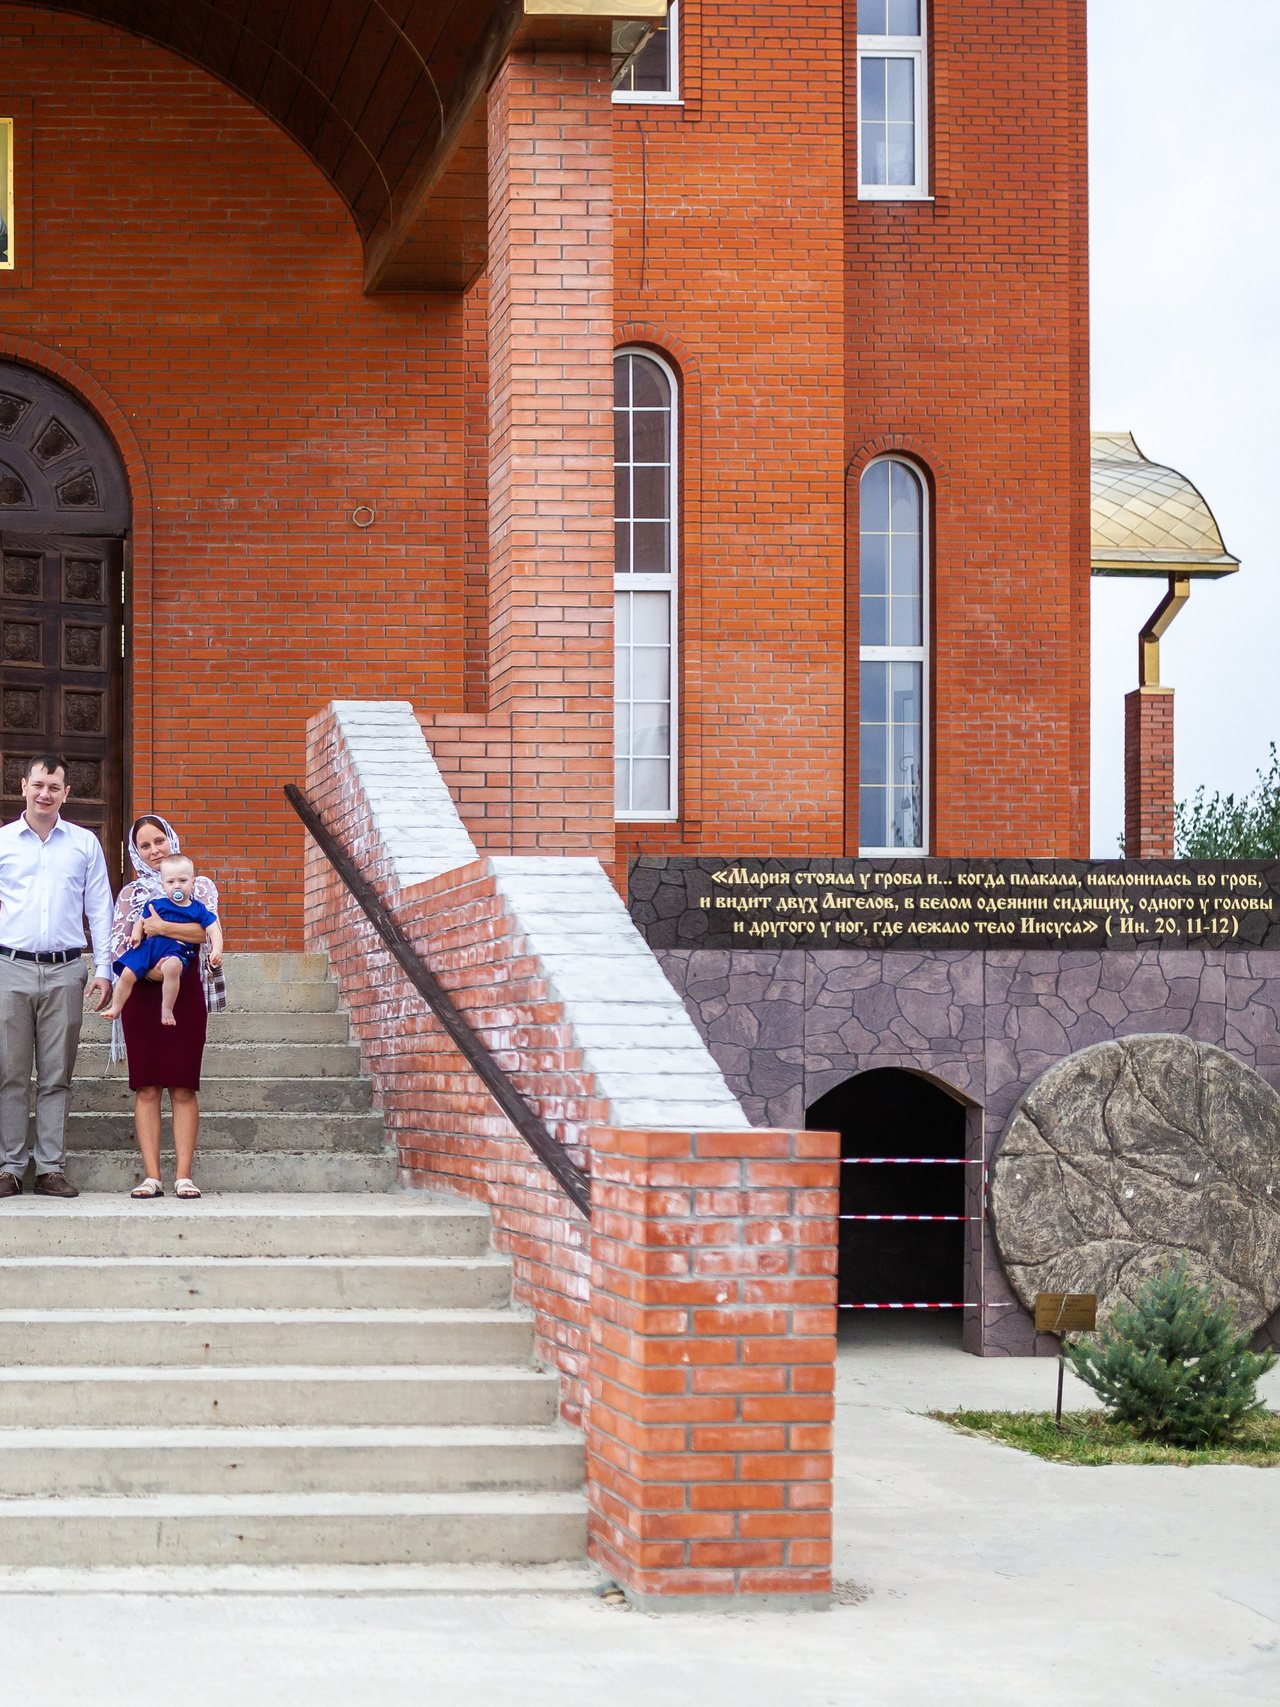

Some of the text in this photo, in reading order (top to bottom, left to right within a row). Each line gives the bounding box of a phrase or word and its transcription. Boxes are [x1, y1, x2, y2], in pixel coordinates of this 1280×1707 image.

[794, 872, 856, 885] стояла
[858, 872, 871, 891] у
[874, 872, 923, 889] гроба
[927, 873, 953, 885] и...
[957, 872, 1006, 889] когда
[1009, 873, 1082, 889] плакала,
[1086, 873, 1192, 887] наклонилась
[1196, 873, 1216, 887] во
[1220, 873, 1262, 891] гроб,
[699, 892, 1273, 915] и видит двух Ангелов, в белом одеянии сидящих, одного у головы
[733, 921, 745, 933] и
[747, 920, 816, 939] другого
[819, 921, 832, 939] у
[834, 920, 868, 936] ног,
[872, 921, 904, 937] где
[907, 921, 970, 934] лежало
[973, 921, 1016, 934] тело
[1119, 917, 1150, 934] Ин.
[1154, 917, 1181, 937] 20,
[1186, 915, 1239, 938] 11-12)
